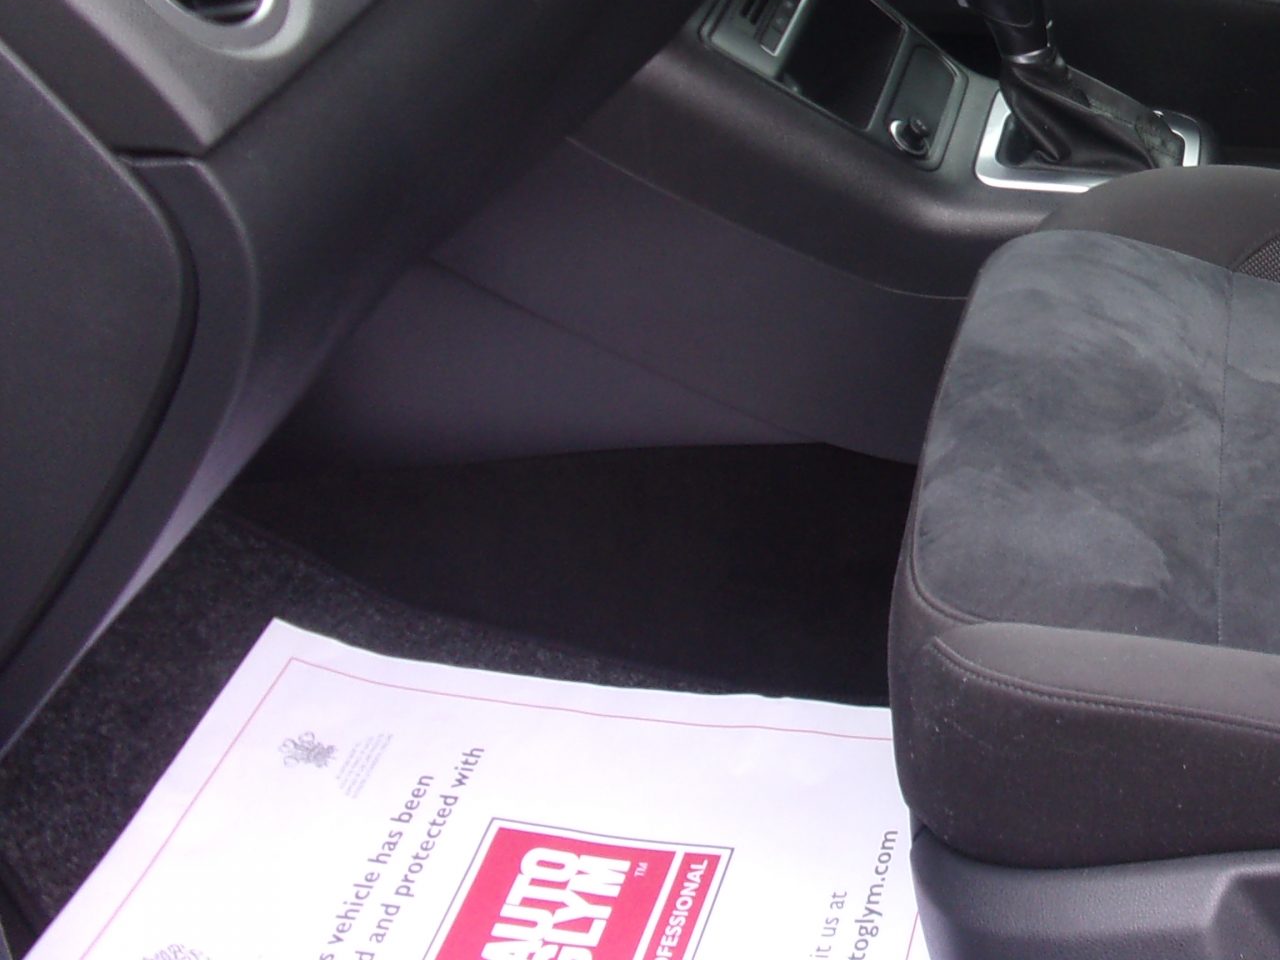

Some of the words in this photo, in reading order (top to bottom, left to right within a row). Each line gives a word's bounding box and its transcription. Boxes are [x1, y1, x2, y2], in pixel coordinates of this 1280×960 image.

[328, 871, 380, 944] vehicle
[367, 830, 403, 865] has
[390, 774, 434, 824] been
[369, 903, 401, 943] and
[394, 794, 459, 897] protected
[451, 746, 485, 788] with
[653, 859, 708, 960] FESSIONAL
[821, 916, 839, 937] us
[829, 891, 848, 909] at
